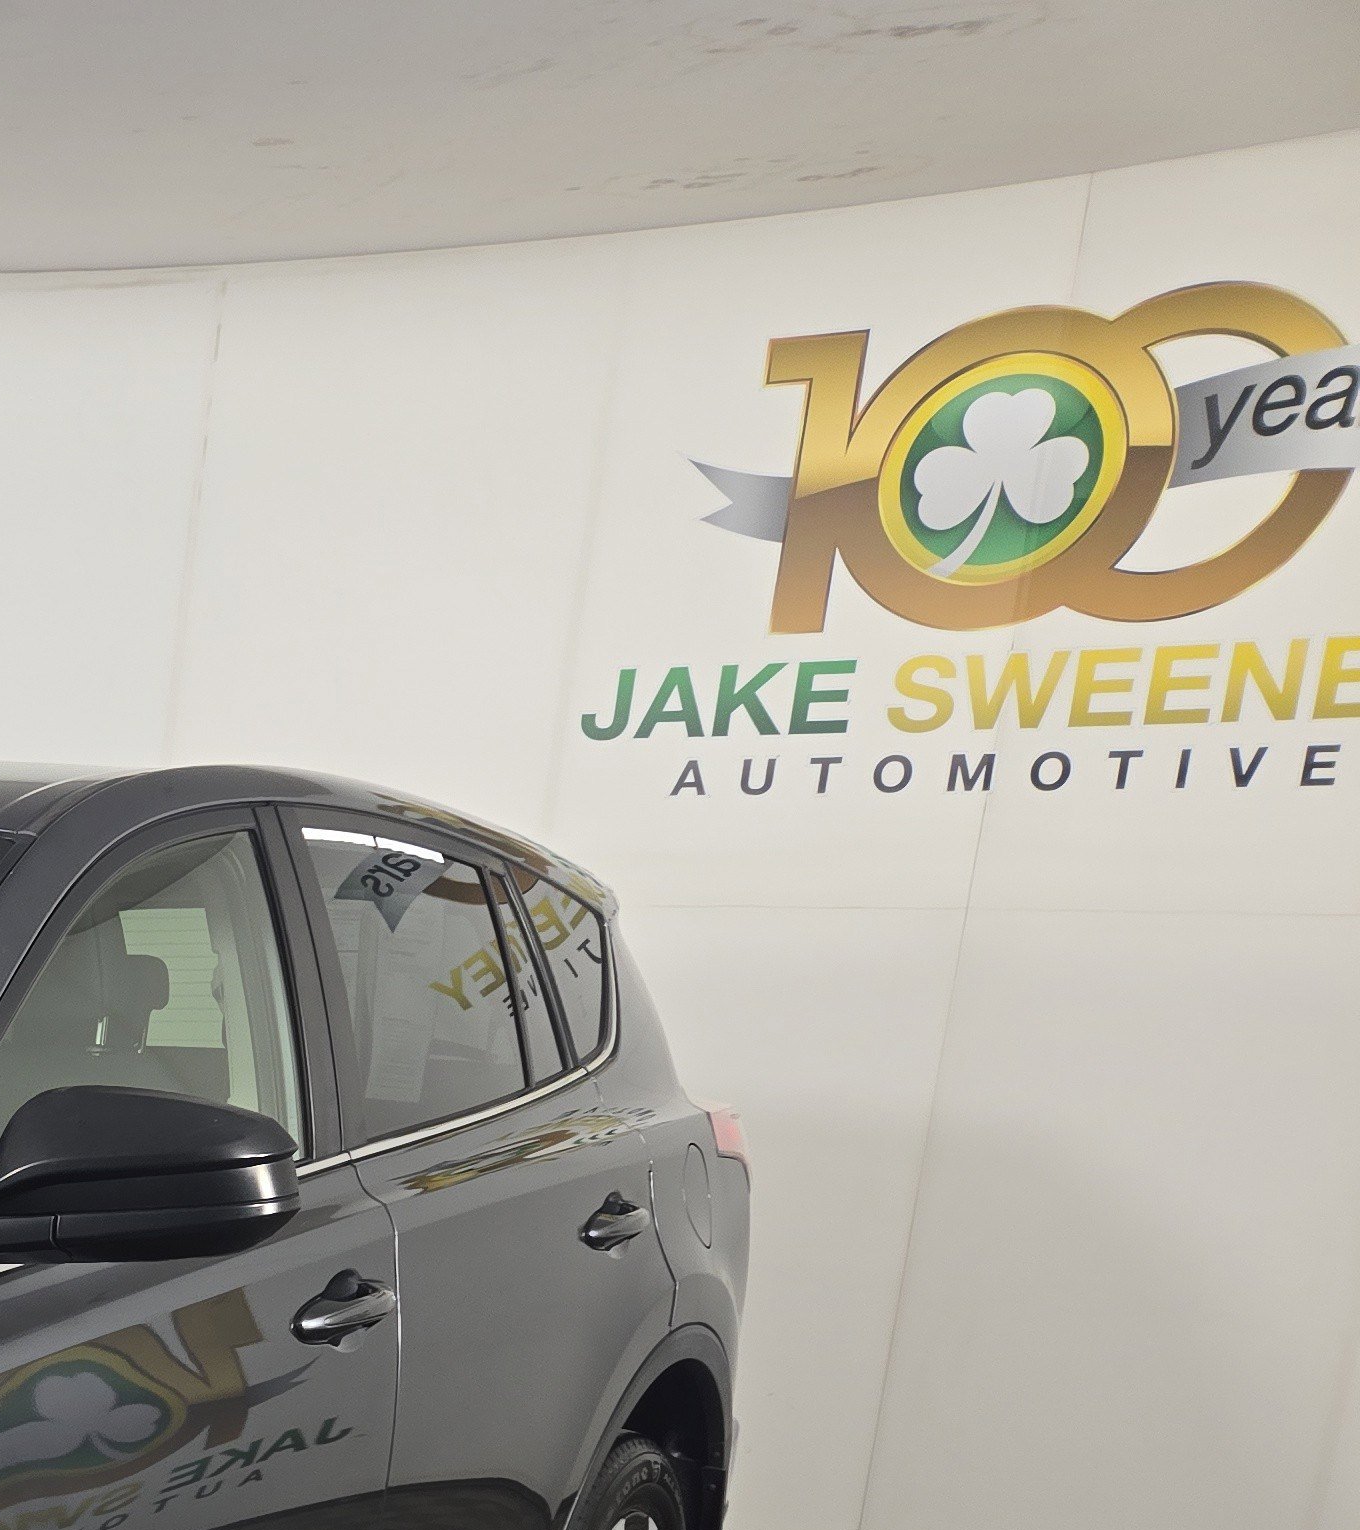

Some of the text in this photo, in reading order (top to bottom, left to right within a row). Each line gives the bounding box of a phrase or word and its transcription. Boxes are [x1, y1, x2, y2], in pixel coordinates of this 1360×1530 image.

[766, 281, 1356, 635] 100
[580, 659, 857, 741] JAKE
[669, 744, 1341, 796] AUTOMOTIVE
